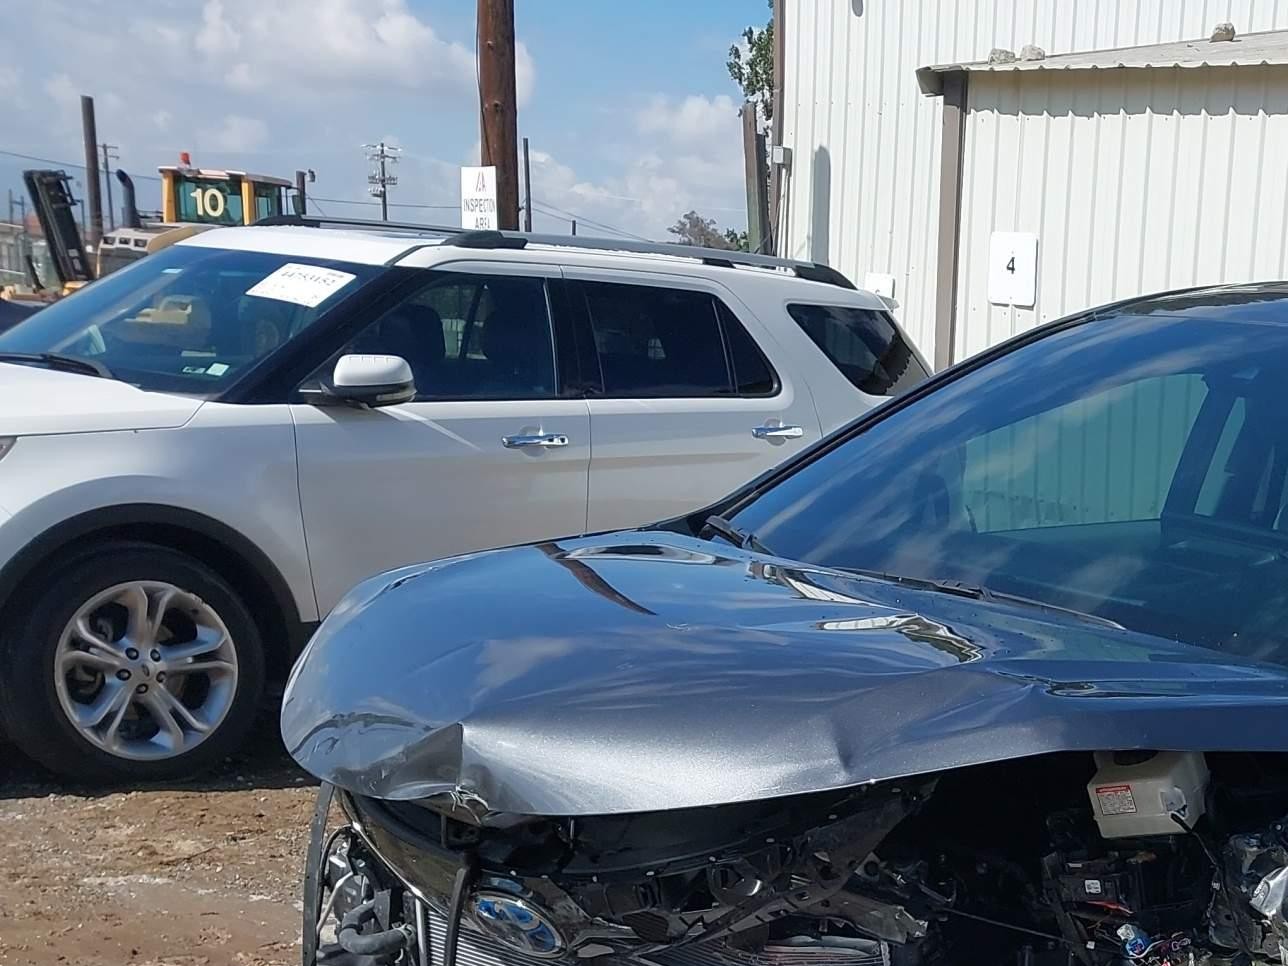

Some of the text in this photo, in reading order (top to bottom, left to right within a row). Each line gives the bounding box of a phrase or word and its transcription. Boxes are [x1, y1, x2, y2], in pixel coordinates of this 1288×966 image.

[190, 188, 224, 217] 10
[463, 198, 496, 213] INSPECTION
[1006, 256, 1016, 275] 4
